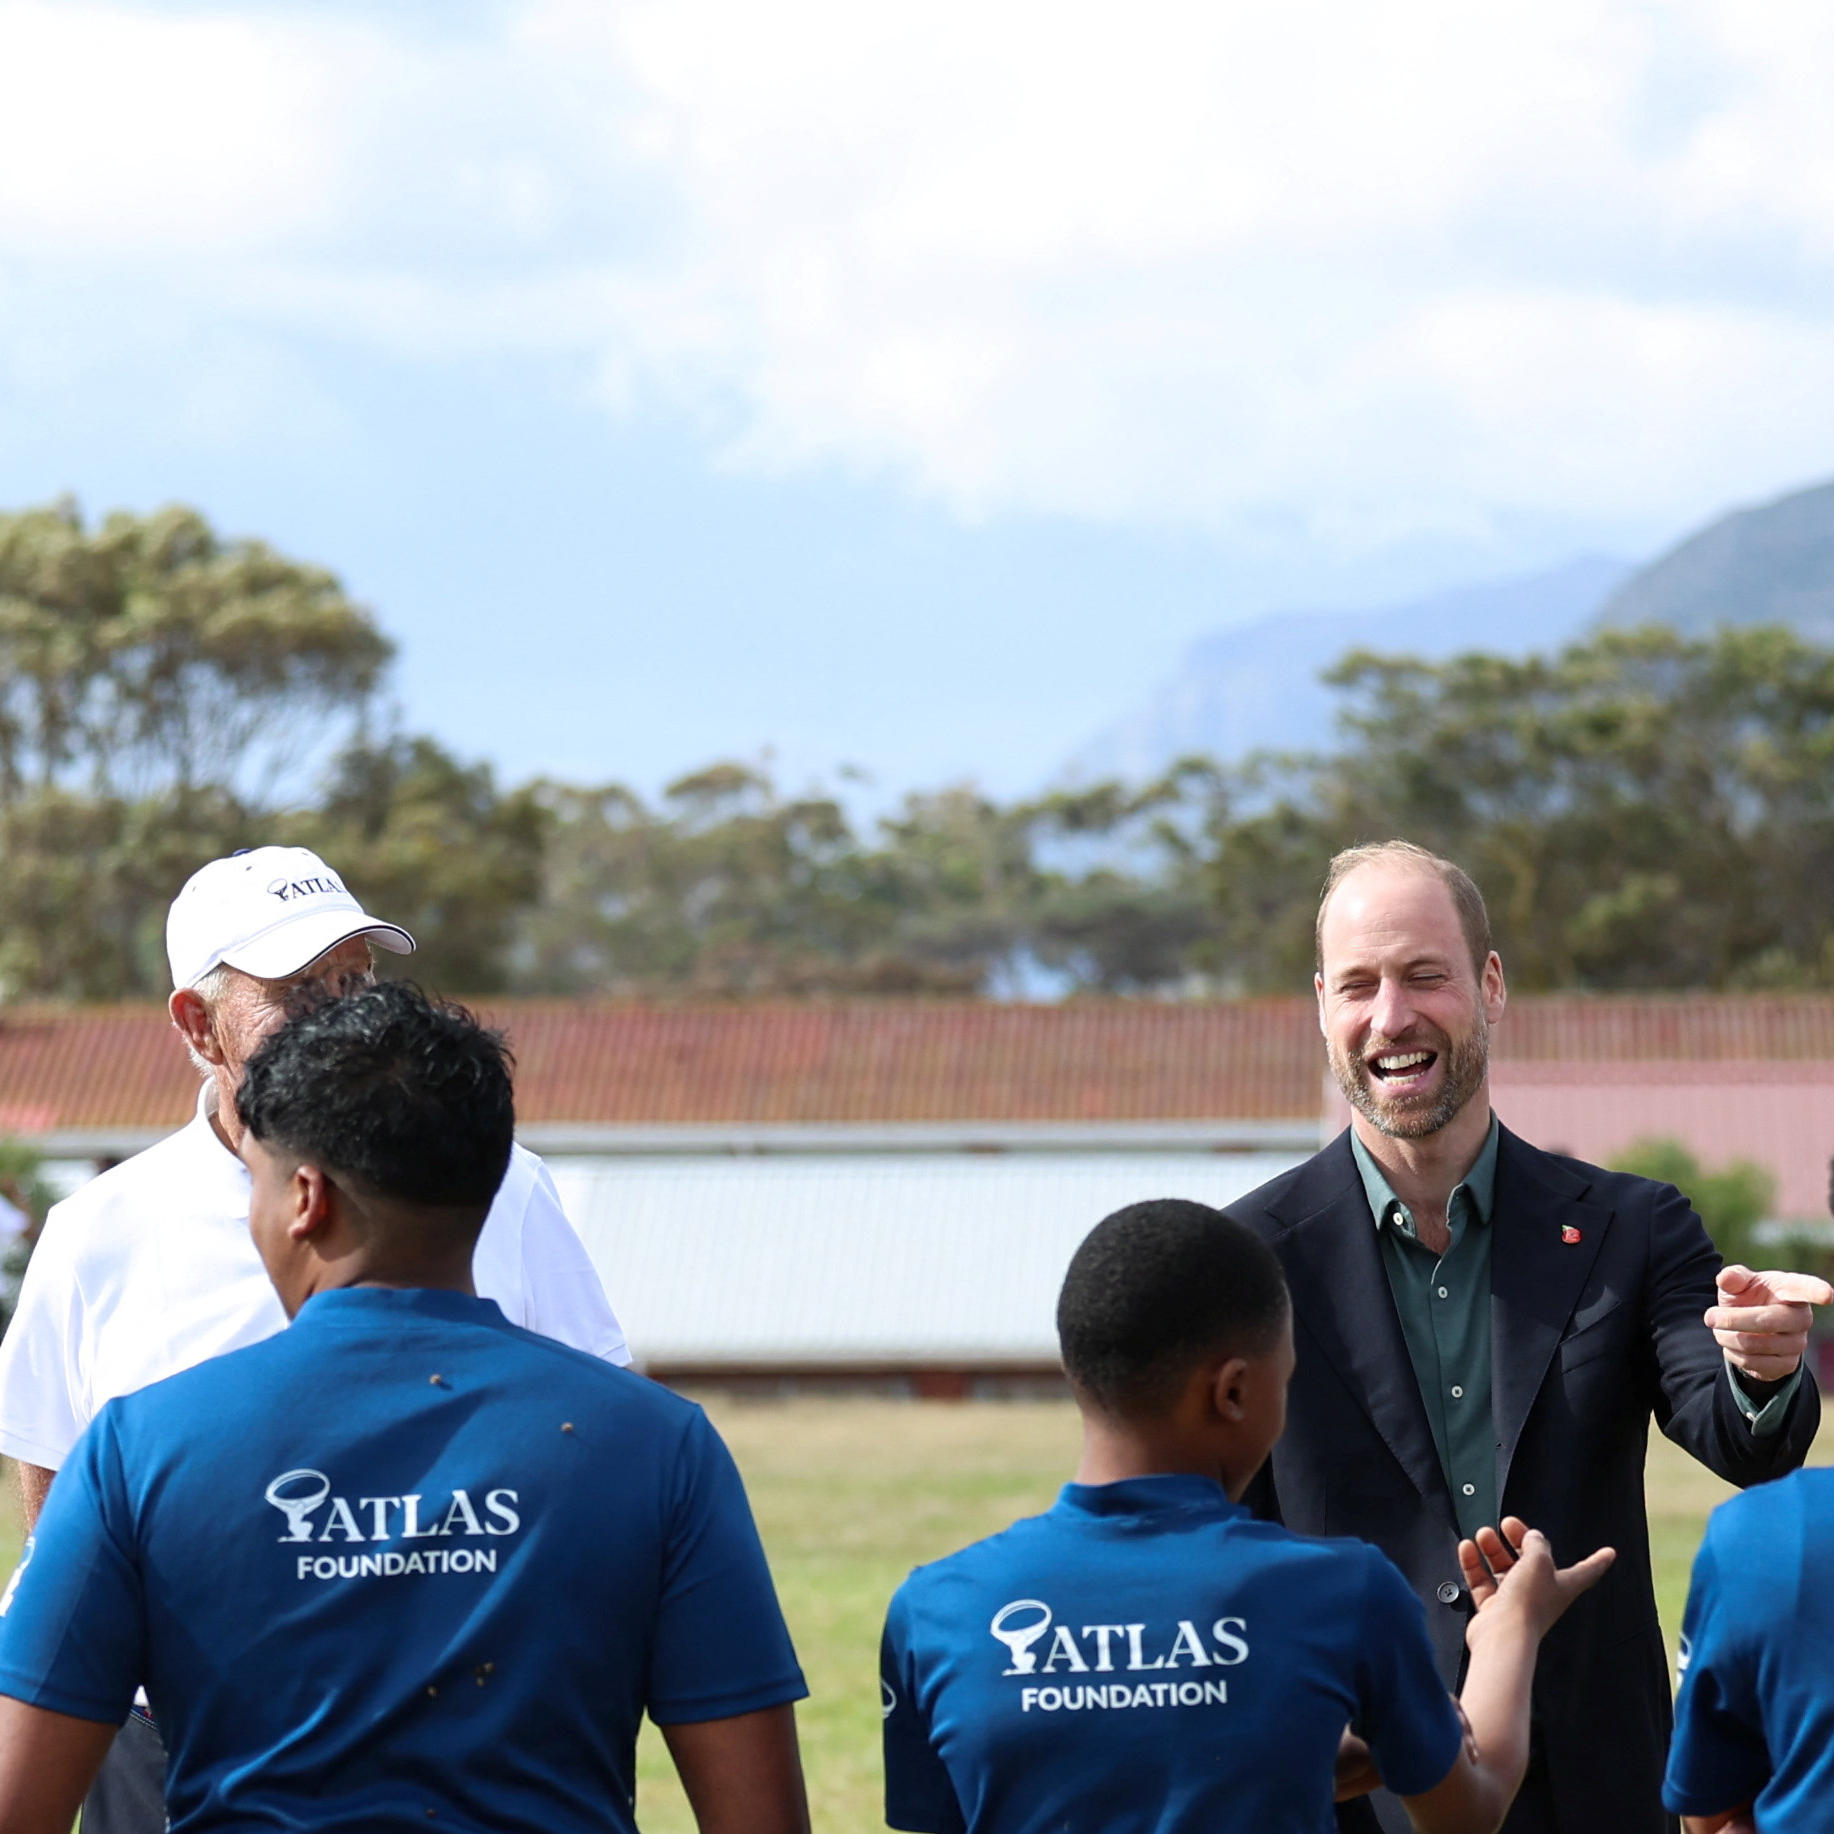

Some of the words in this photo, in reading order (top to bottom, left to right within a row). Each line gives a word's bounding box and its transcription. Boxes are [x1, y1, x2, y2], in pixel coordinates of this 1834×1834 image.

[318, 1489, 520, 1542] ATLAS
[297, 1549, 497, 1579] FOUNDATION
[1041, 1617, 1250, 1673] ATLAS
[1022, 1680, 1227, 1712] FOUNDATION
